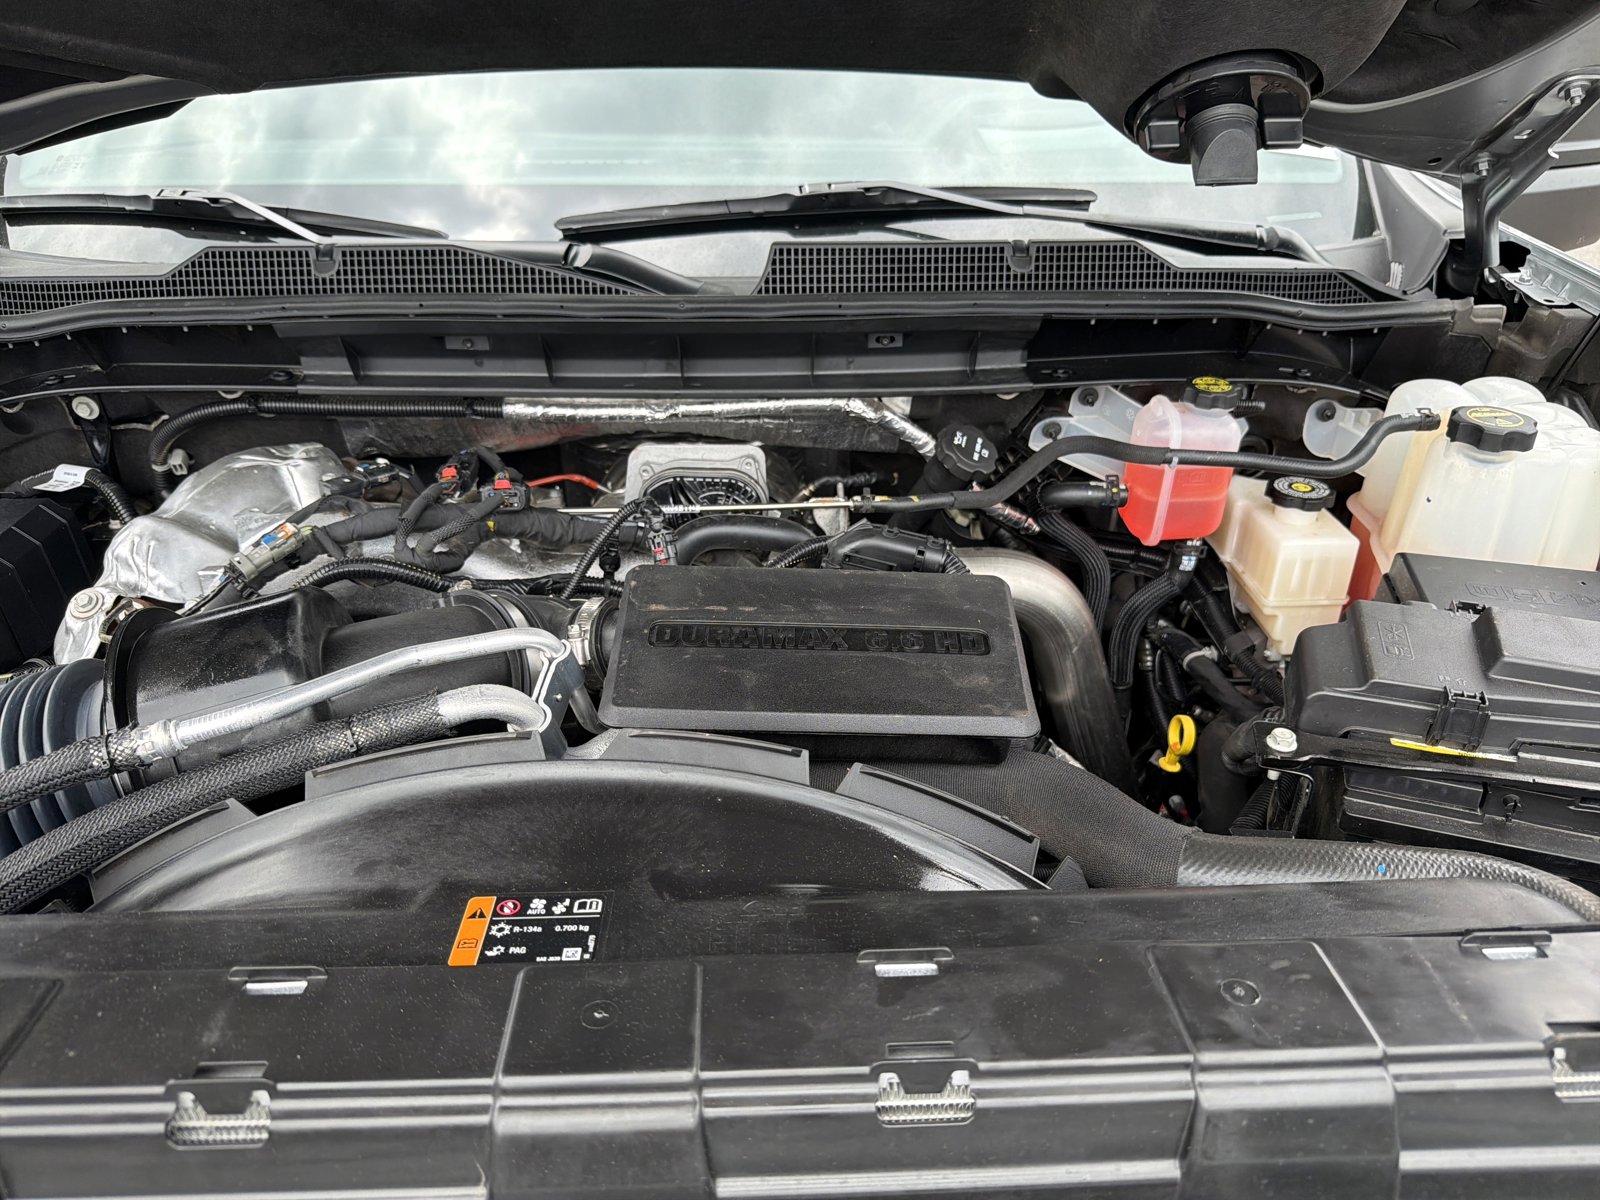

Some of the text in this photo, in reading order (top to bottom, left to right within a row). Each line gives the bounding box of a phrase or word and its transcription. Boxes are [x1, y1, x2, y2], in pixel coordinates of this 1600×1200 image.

[654, 624, 987, 654] DURAMAX 6.6 HD
[578, 924, 590, 933] kg
[509, 946, 527, 954] PAG
